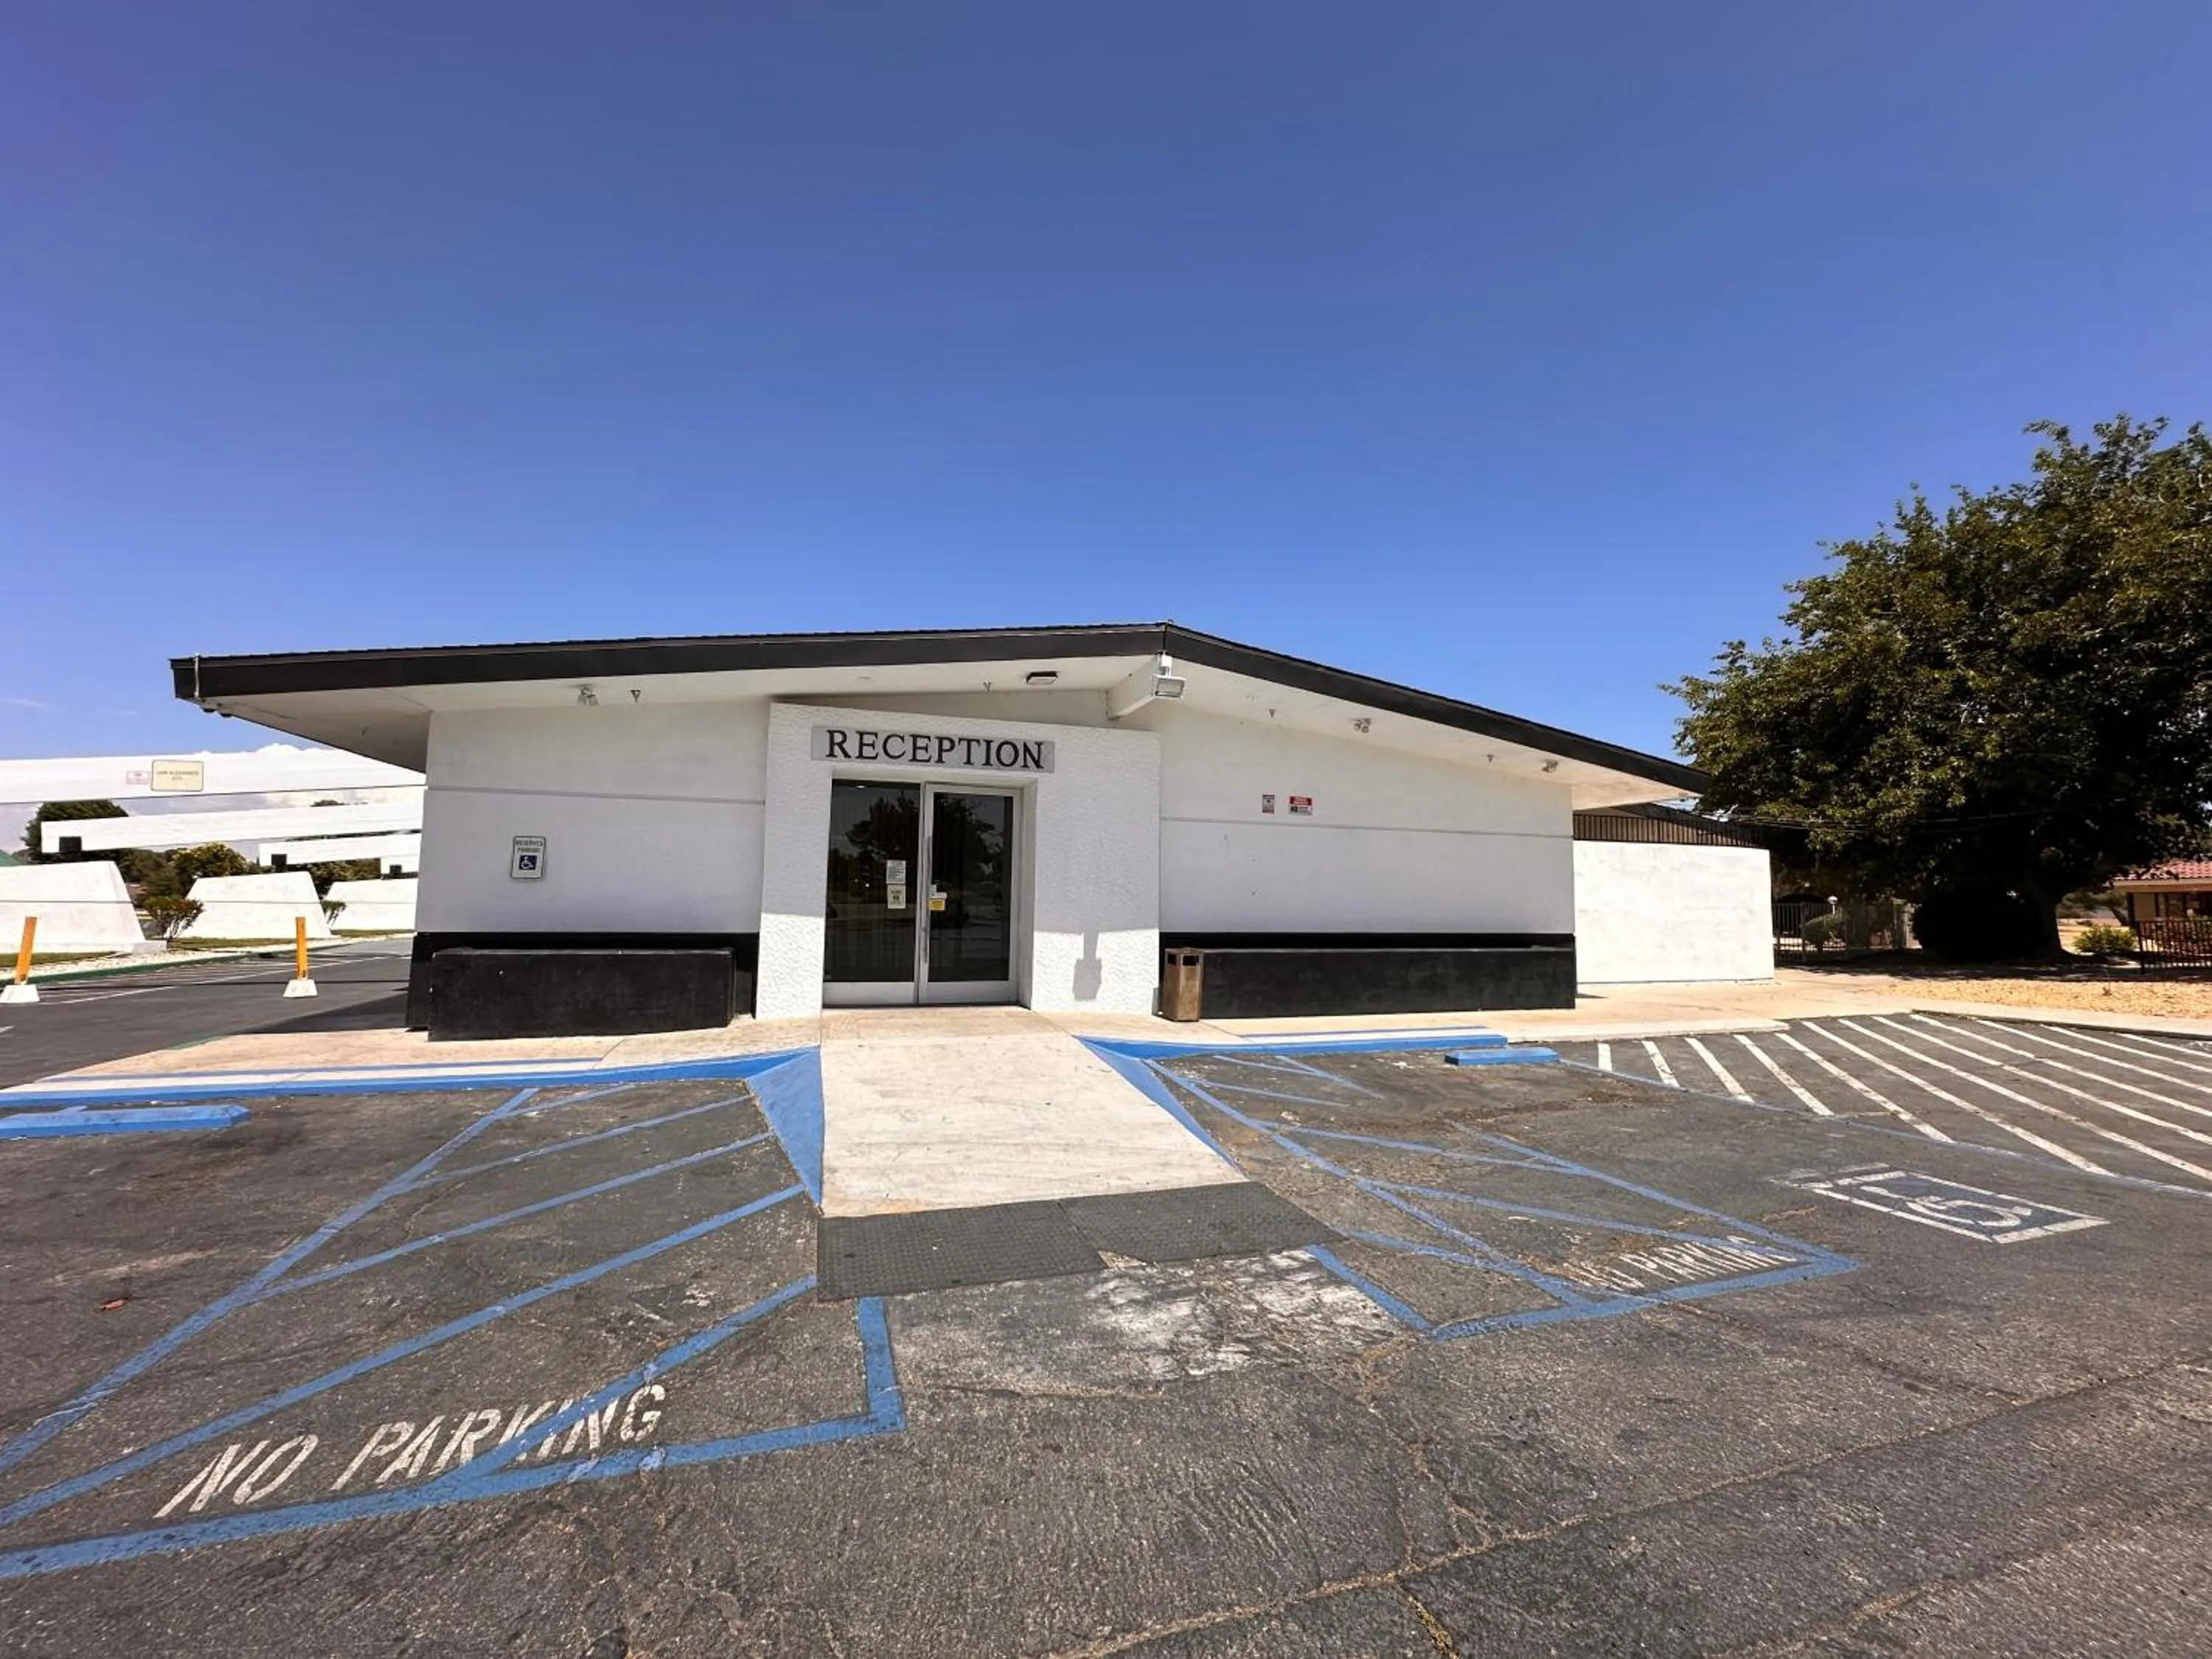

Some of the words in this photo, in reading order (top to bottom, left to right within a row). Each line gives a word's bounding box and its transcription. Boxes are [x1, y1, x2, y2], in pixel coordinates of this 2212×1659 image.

[825, 729, 1045, 769] RECEPTION
[153, 1435, 319, 1518] NO
[330, 1385, 665, 1491] PARKING
